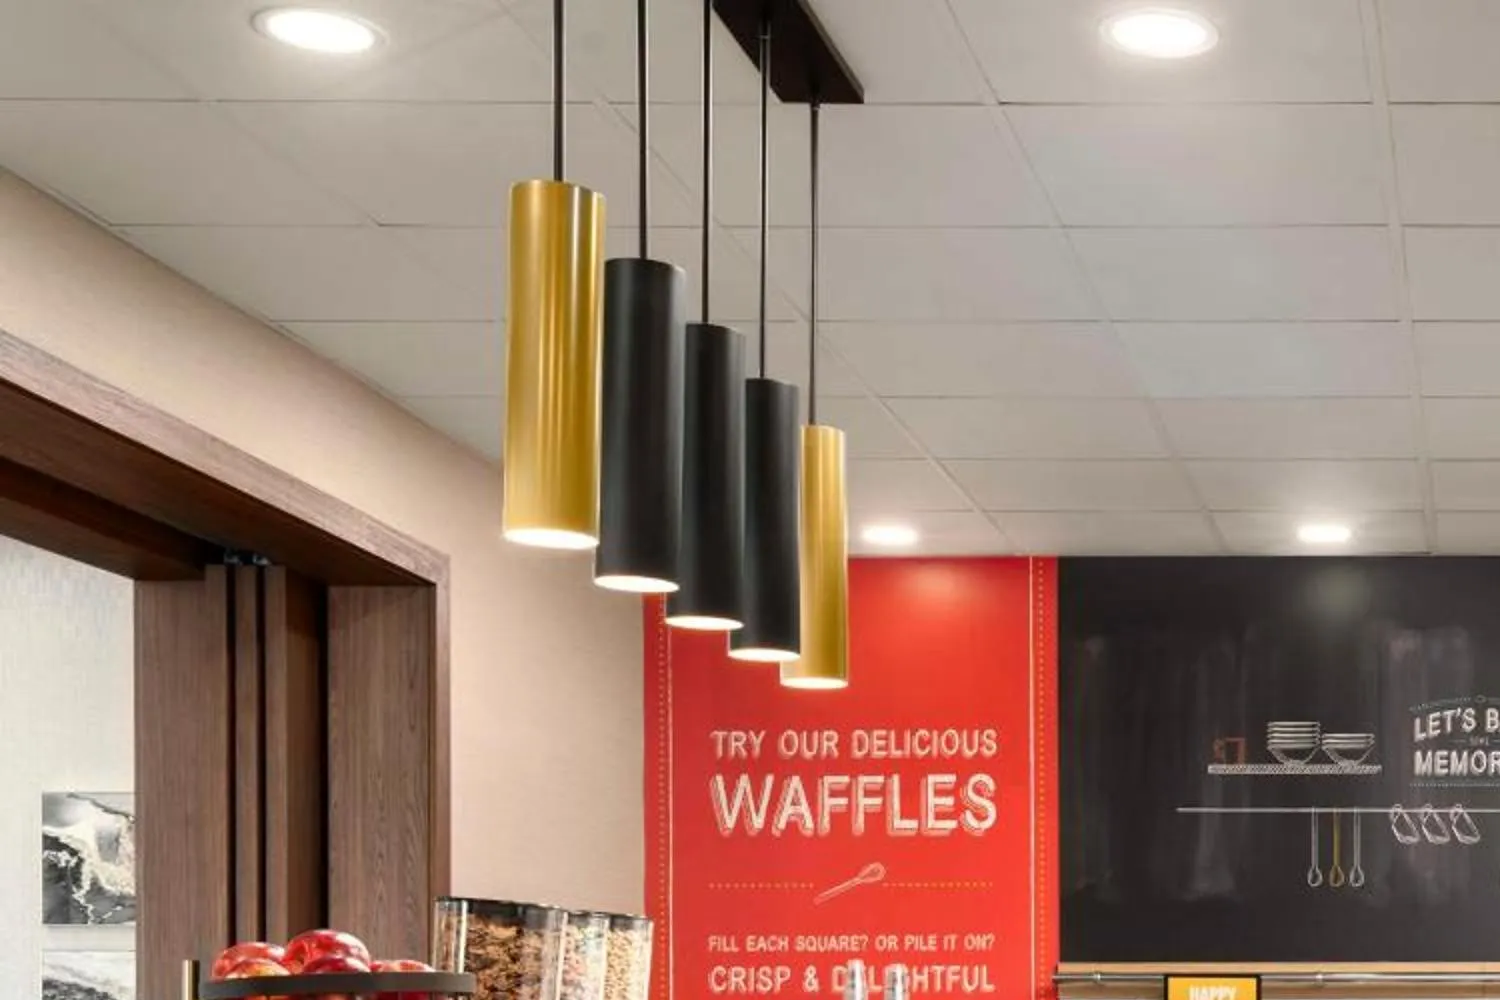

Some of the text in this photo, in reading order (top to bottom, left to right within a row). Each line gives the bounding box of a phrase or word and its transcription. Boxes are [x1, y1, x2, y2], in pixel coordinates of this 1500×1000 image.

[1414, 707, 1476, 742] LET'S
[710, 728, 998, 759] TRY OUR DELICIOUS
[709, 773, 997, 837] WAFFLES
[708, 933, 995, 953] FILL EACH SQUARE? OR PILE IT ON?
[708, 964, 996, 993] CRISP & DLHTFUL
